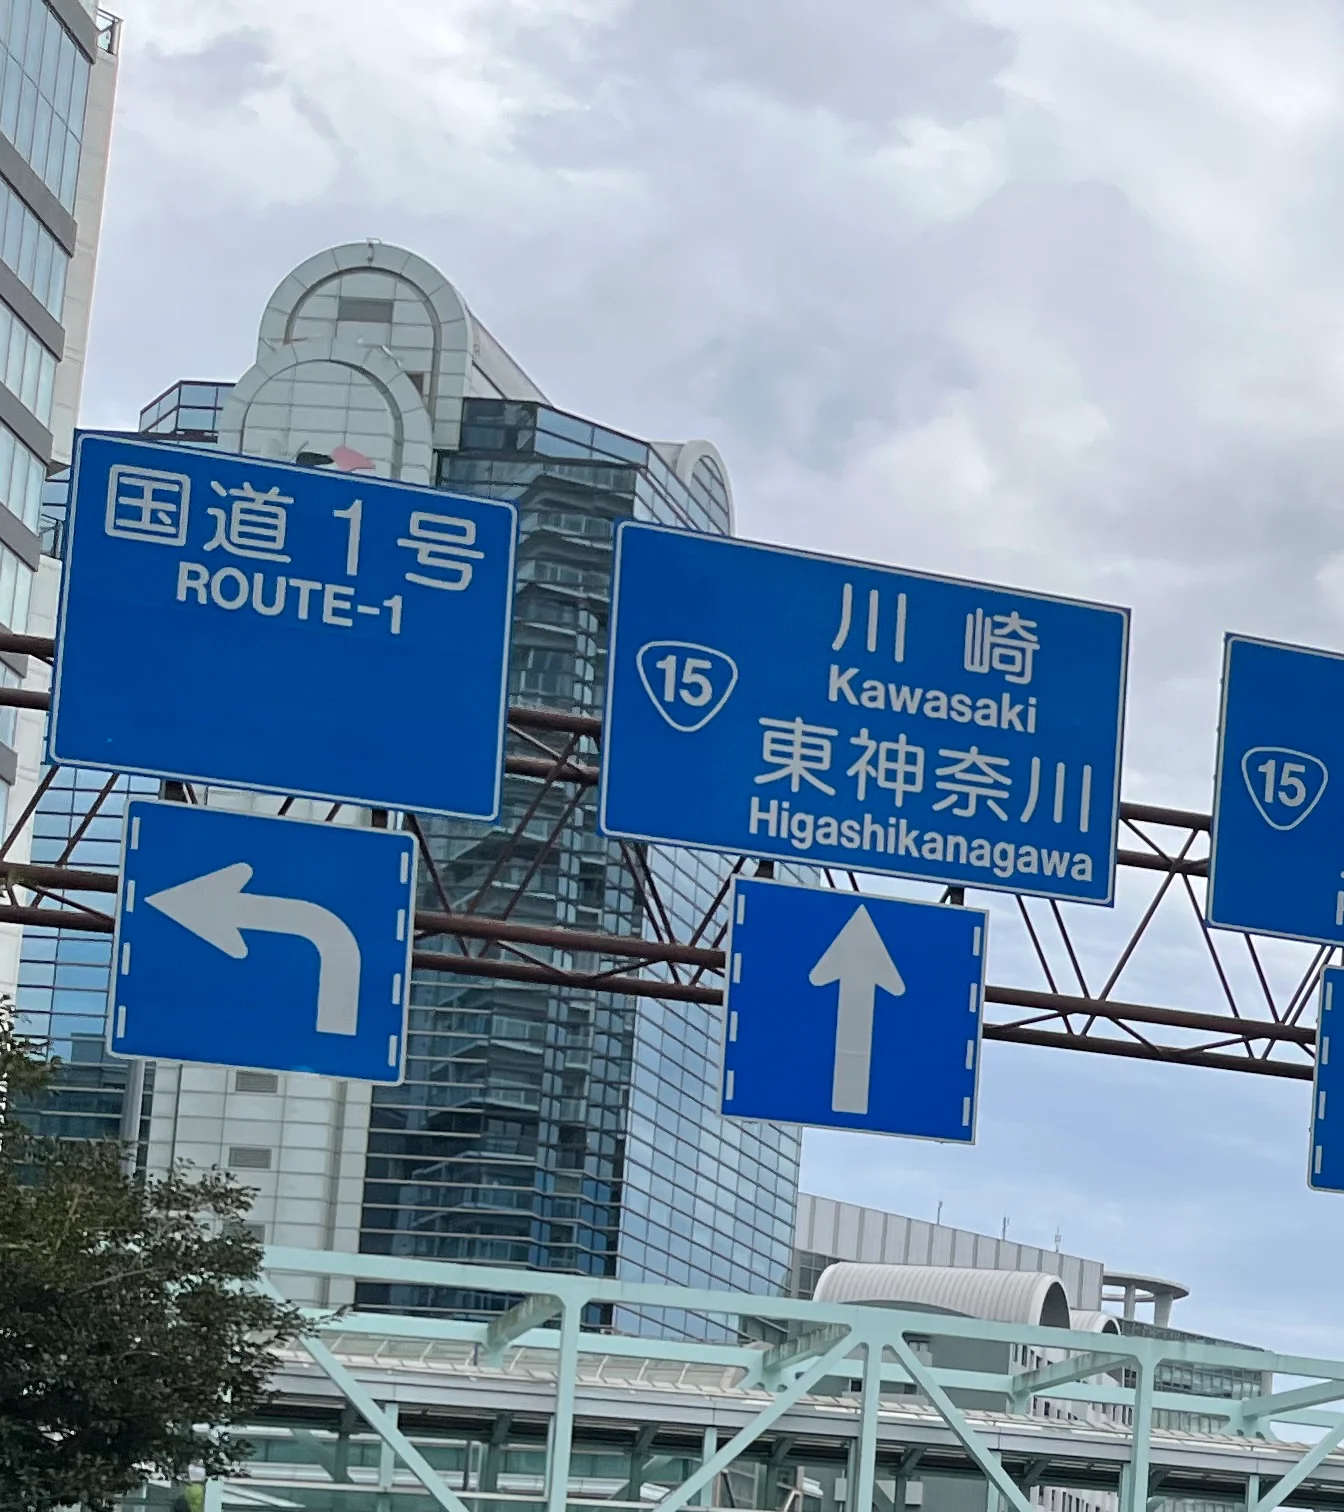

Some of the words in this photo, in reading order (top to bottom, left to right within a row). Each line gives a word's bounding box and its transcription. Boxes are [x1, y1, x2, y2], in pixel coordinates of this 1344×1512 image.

[105, 463, 485, 592] 国道1号
[175, 560, 403, 635] ROUTE-1
[655, 654, 713, 707] 15
[827, 664, 1038, 734] Kawasaki
[753, 716, 1093, 833] 東神奈川
[1257, 758, 1307, 807] 15
[748, 796, 1094, 883] Higashikanagawa
